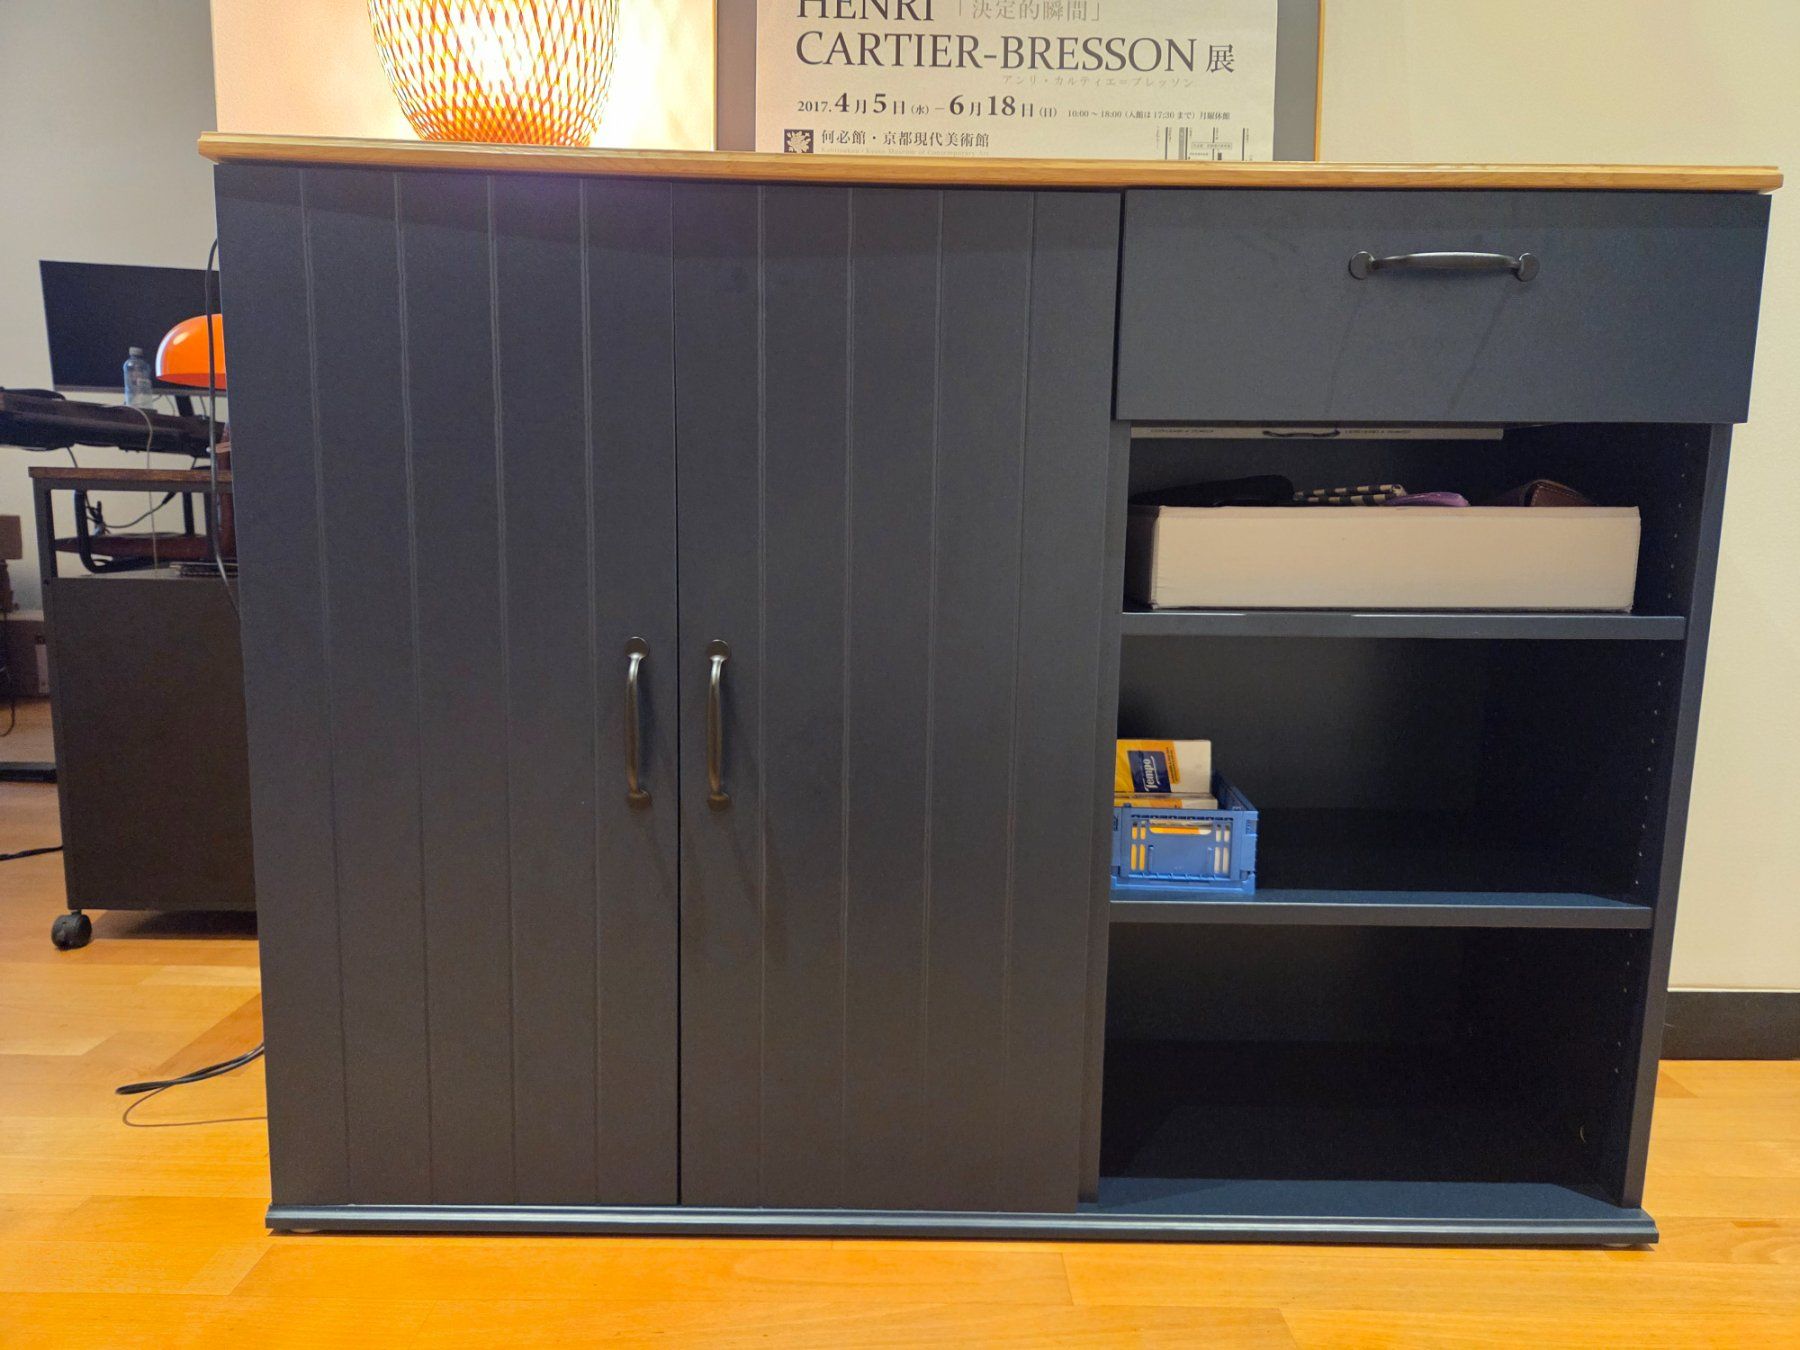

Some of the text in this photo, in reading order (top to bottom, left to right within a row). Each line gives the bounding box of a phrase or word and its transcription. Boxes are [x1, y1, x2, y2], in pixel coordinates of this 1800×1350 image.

[797, 0, 934, 21] HENRI
[796, 30, 1235, 73] CARTIER-BRESSON 展
[820, 129, 990, 148] 何必館・京都現代美術館
[1142, 755, 1161, 792] Tempo
